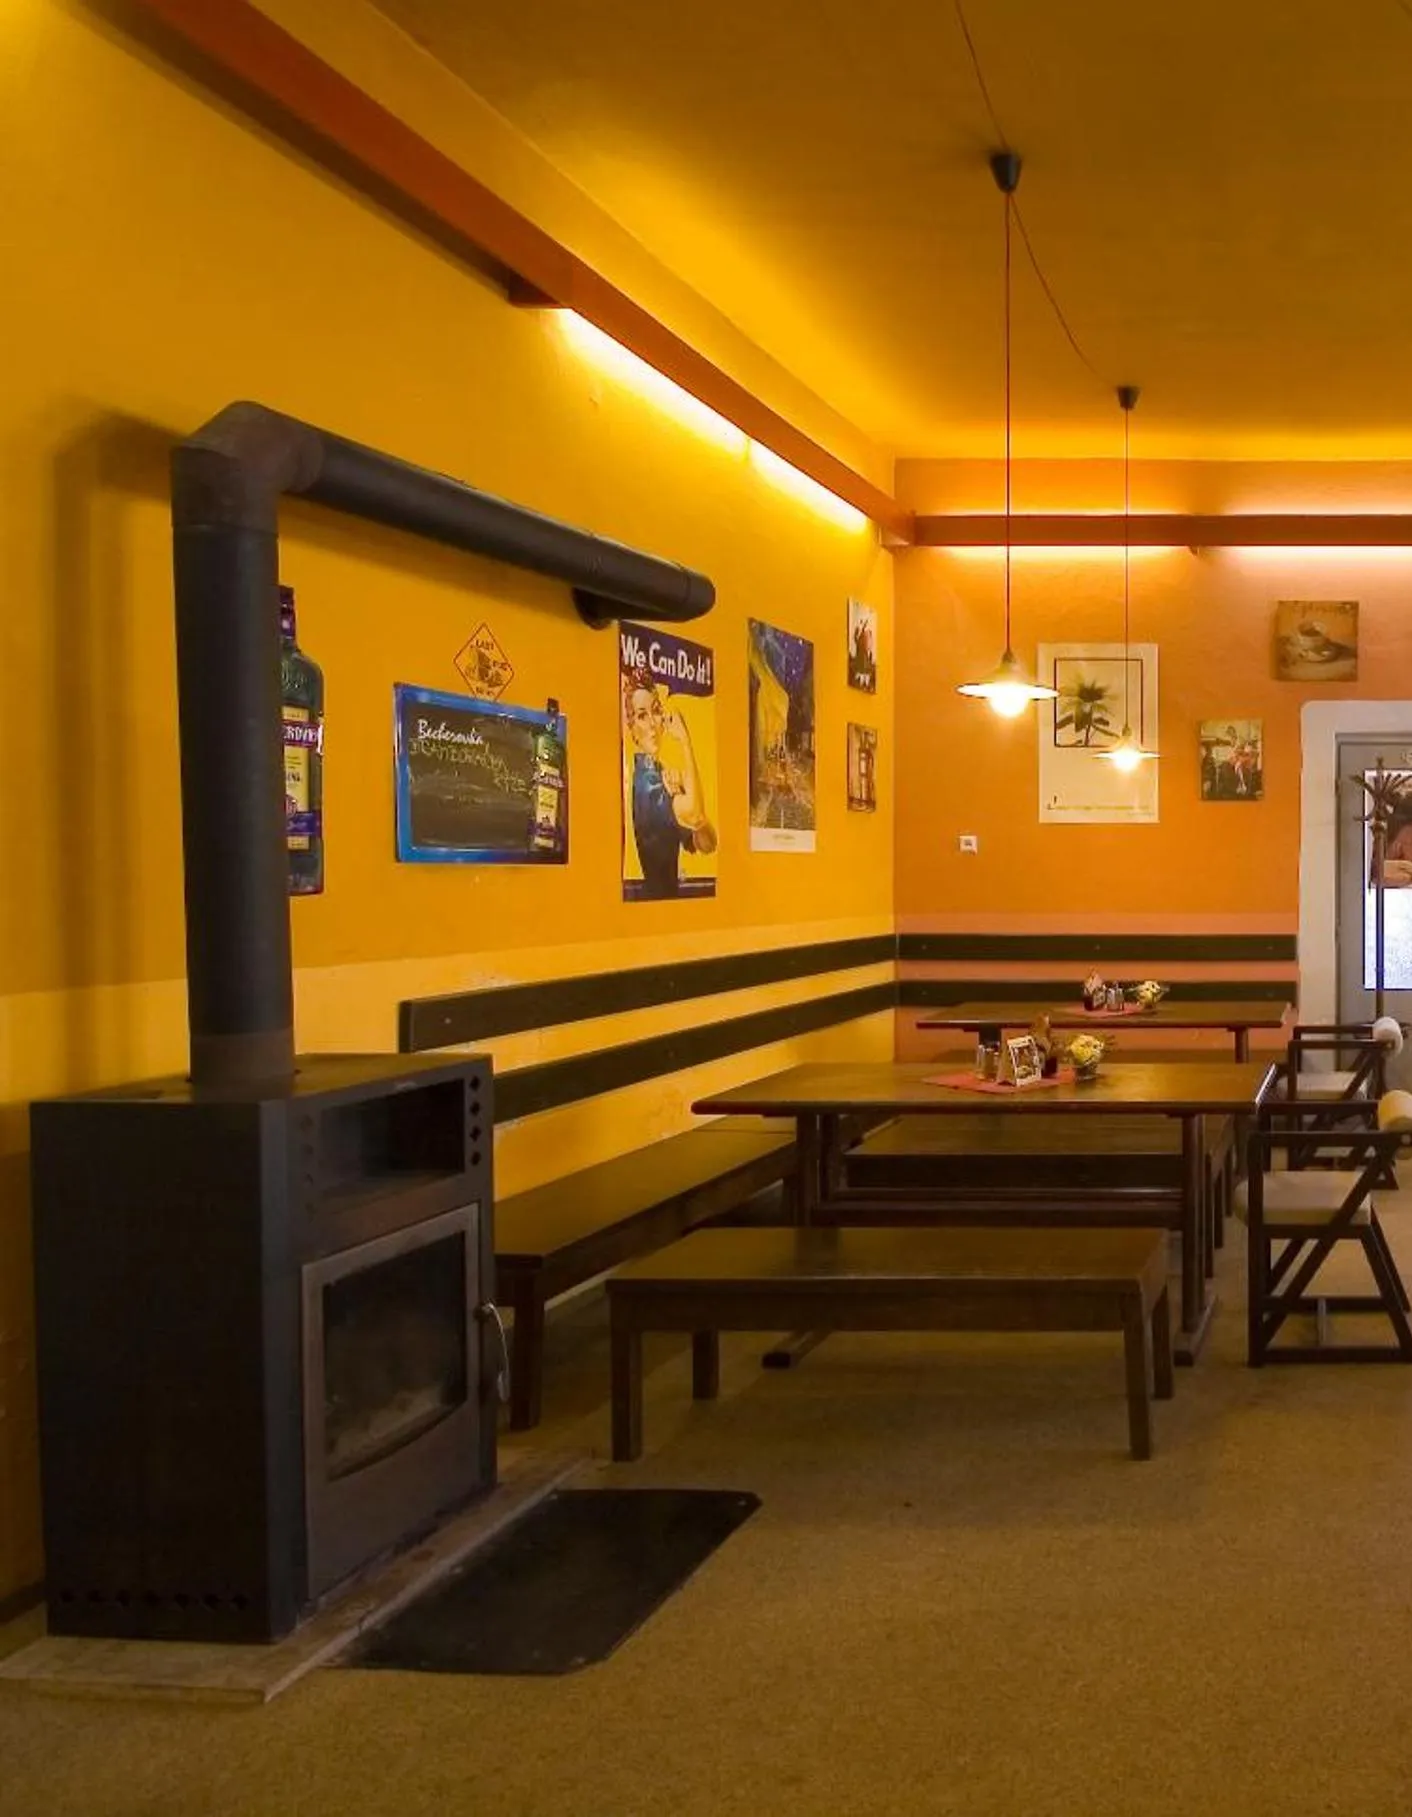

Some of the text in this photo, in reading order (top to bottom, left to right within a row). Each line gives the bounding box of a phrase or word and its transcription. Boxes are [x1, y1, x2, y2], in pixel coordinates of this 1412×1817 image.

[620, 633, 712, 687] We Can Do It!
